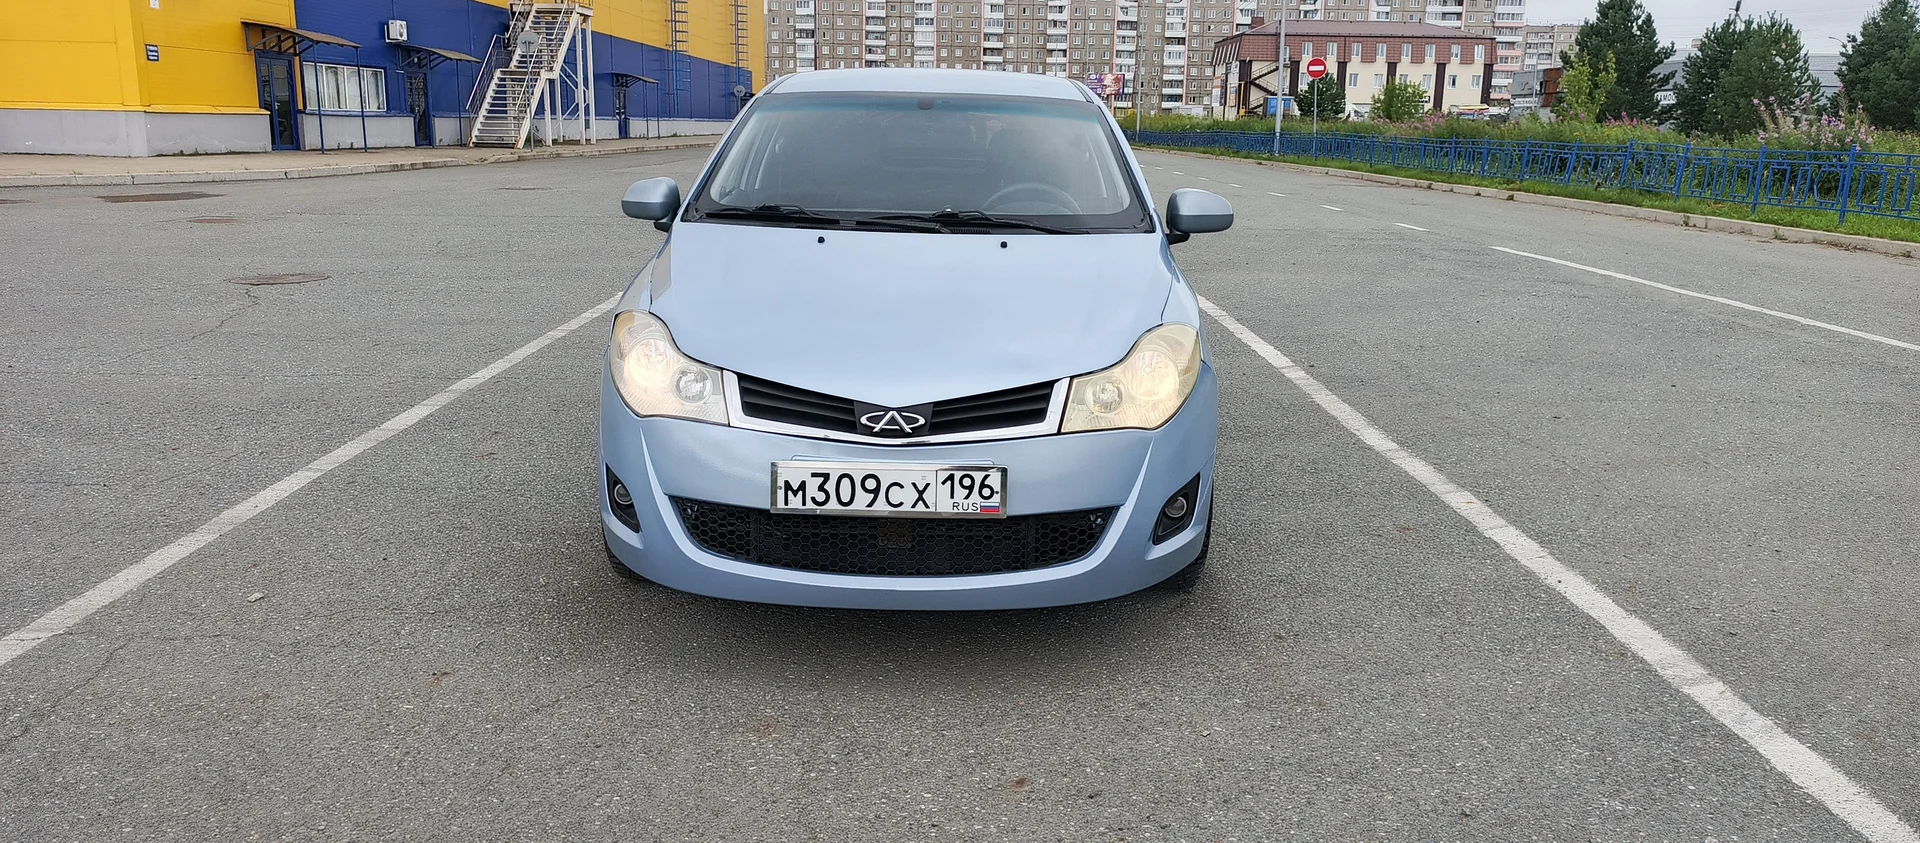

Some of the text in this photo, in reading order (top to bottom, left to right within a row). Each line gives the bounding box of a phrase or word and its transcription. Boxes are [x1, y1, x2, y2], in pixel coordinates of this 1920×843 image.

[784, 472, 994, 509] М309СХ 196
[952, 501, 979, 511] RUS
